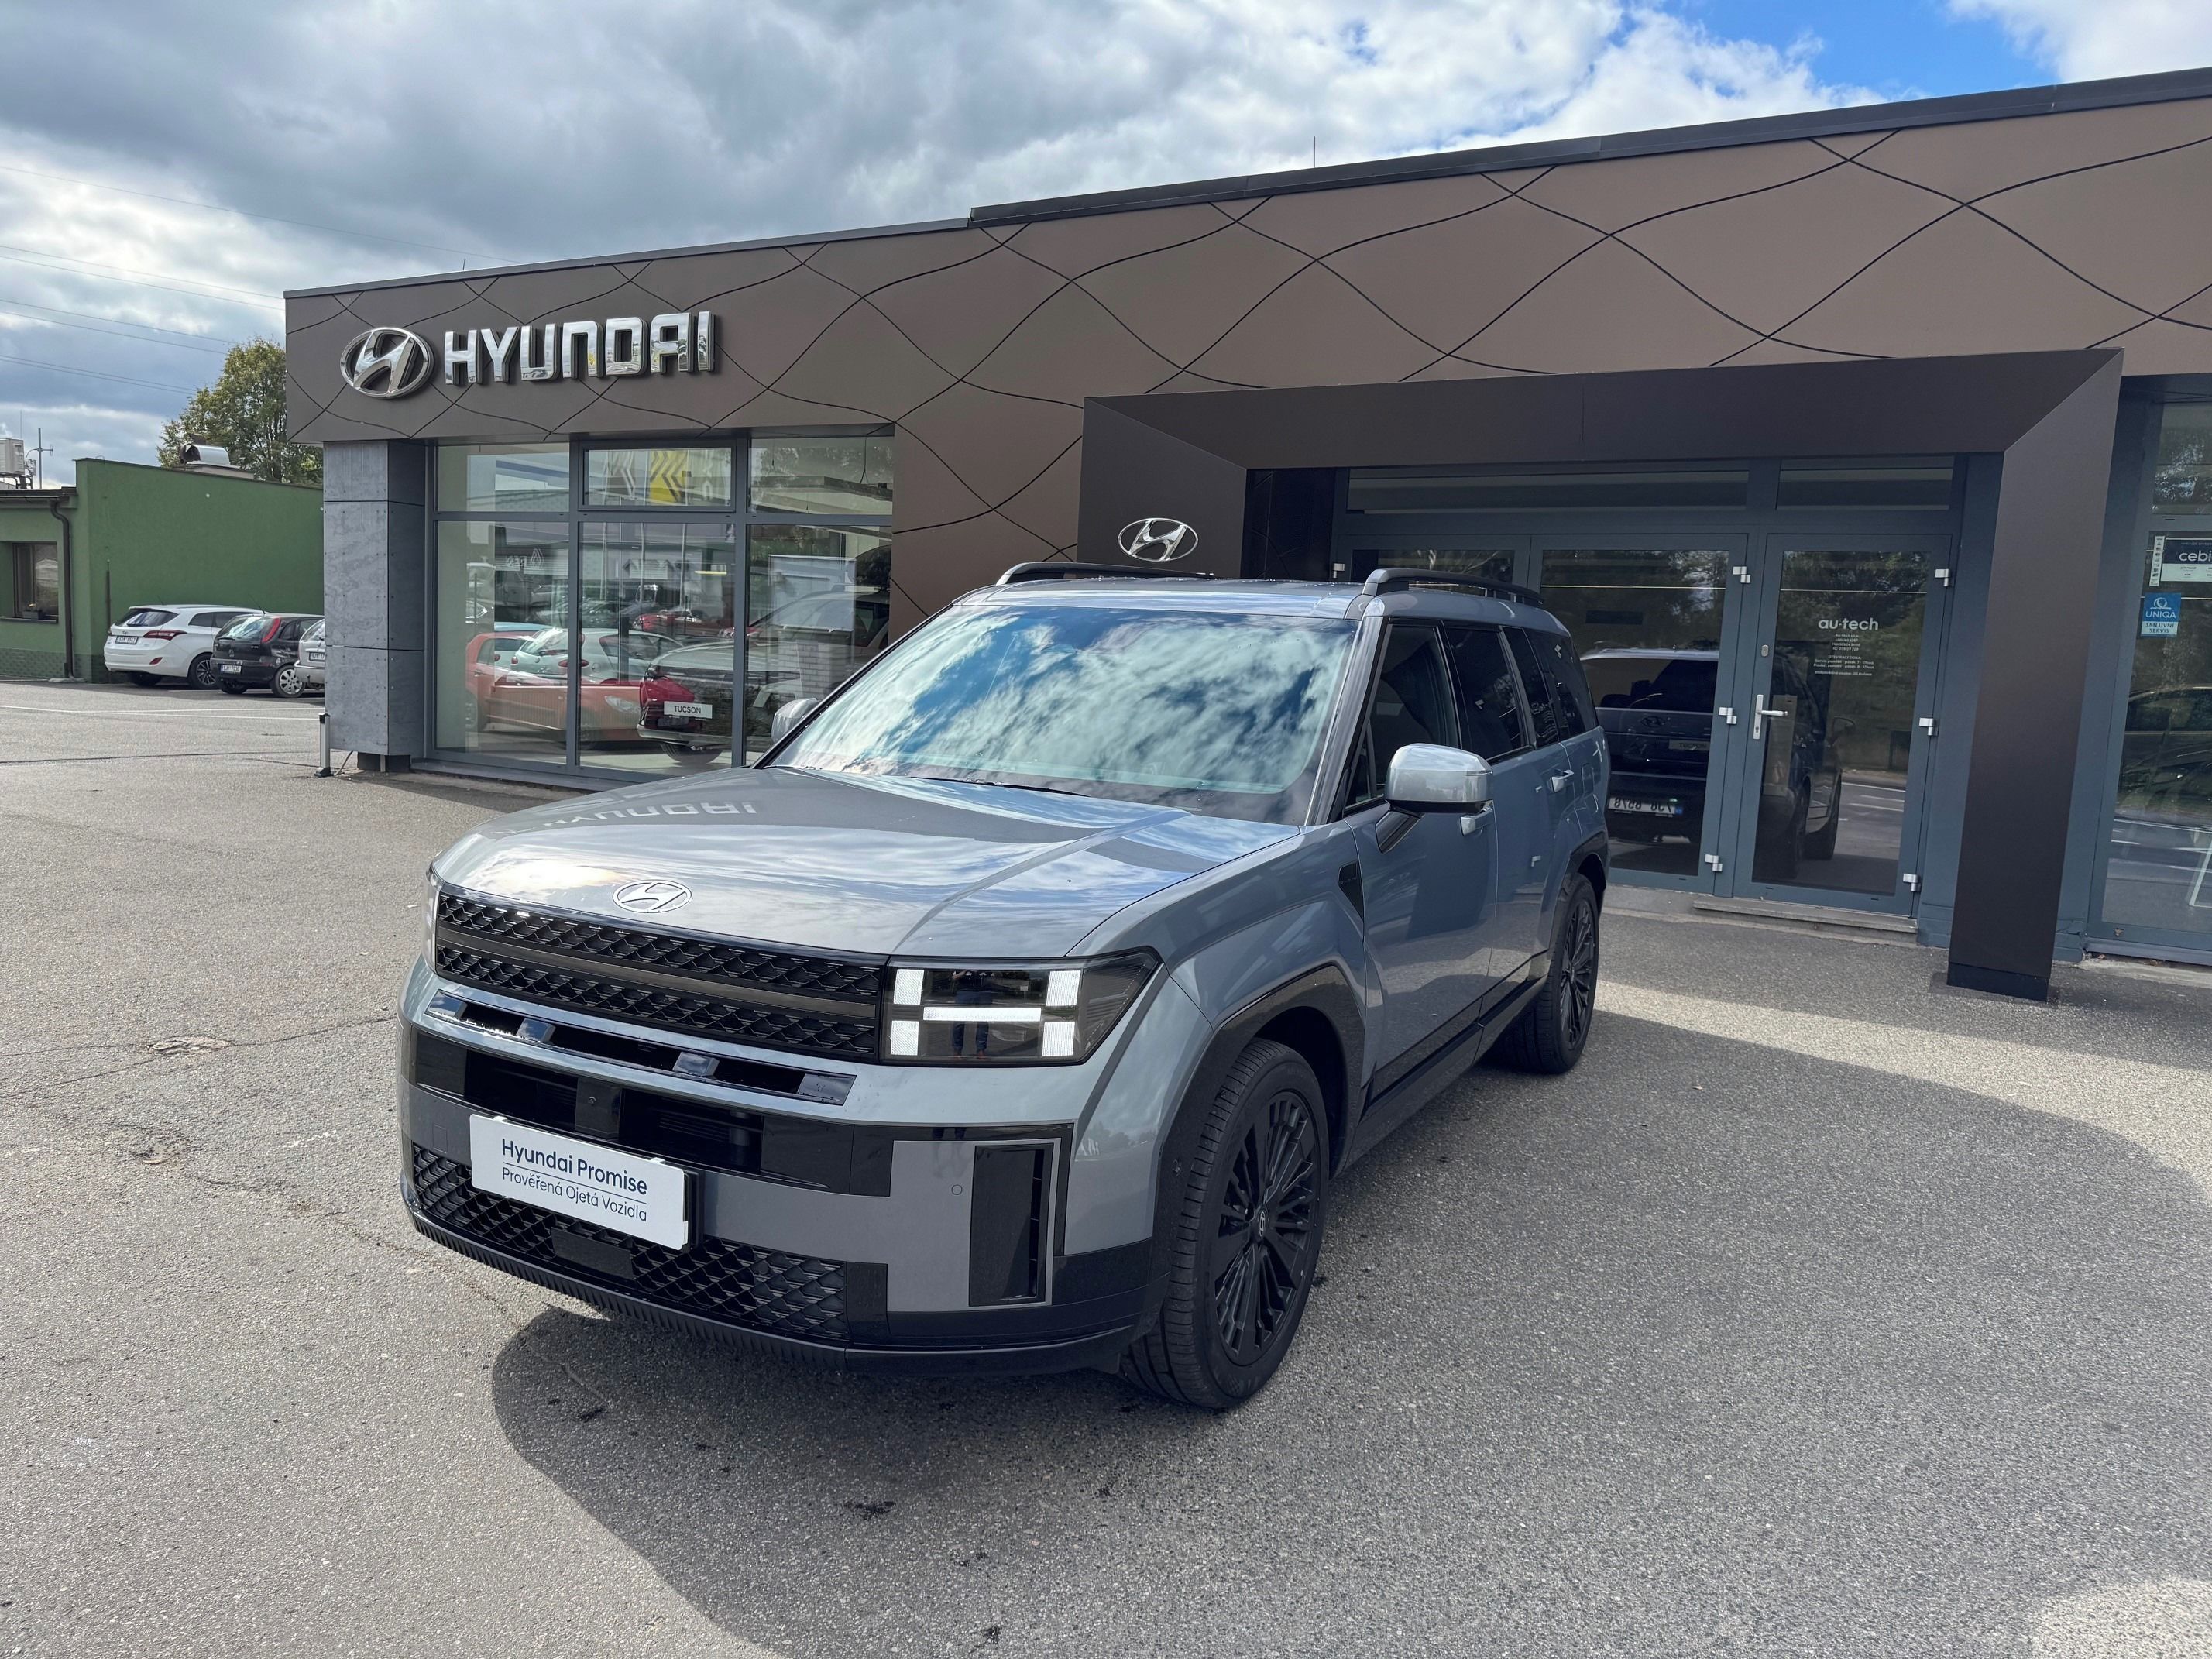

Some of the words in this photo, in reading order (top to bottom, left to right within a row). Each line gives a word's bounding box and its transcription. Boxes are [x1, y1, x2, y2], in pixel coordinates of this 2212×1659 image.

[444, 311, 715, 385] HYUNDAI
[674, 705, 702, 714] TUCSON
[502, 1139, 572, 1173] Hyundai
[577, 1158, 647, 1195] Promise
[503, 1167, 562, 1197] Prověřená
[565, 1185, 599, 1207] Ojetá
[601, 1195, 647, 1222] Vozidla
